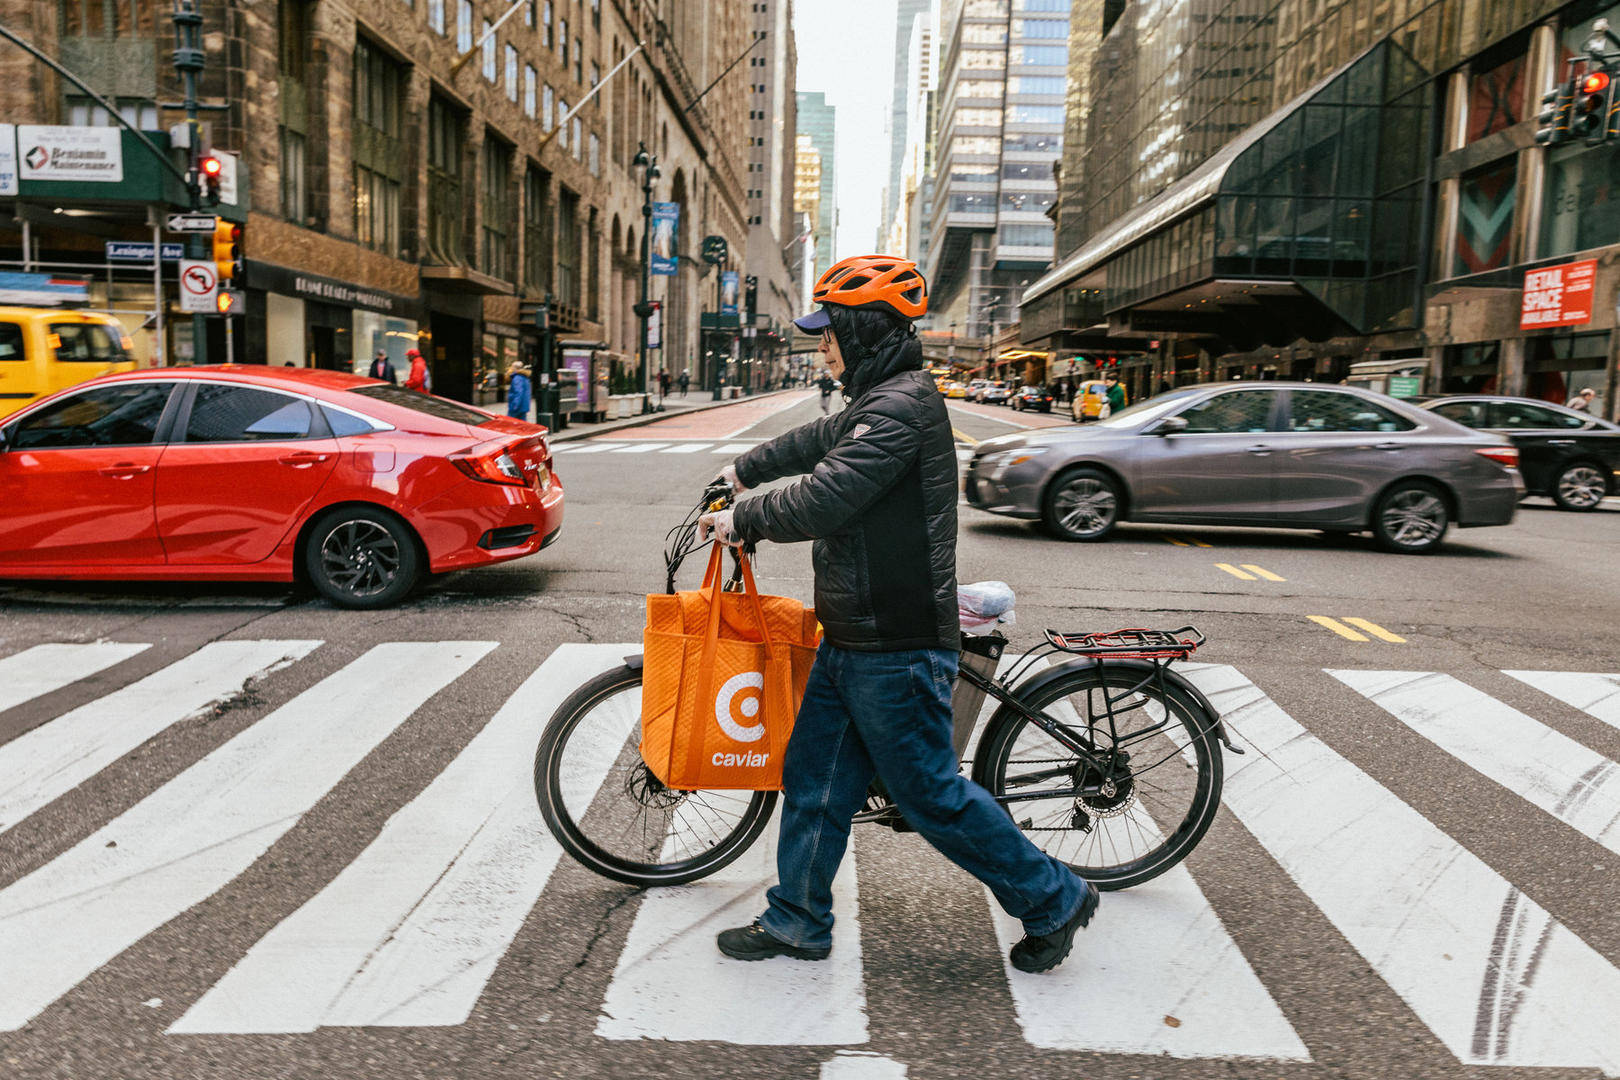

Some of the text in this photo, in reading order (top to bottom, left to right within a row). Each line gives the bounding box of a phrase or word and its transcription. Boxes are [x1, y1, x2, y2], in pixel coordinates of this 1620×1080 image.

[51, 147, 106, 160] Benjamin
[50, 160, 116, 170] Maintenance
[108, 244, 183, 258] Lexingto Ave
[1525, 268, 1564, 292] RETAIL
[1523, 287, 1563, 312] SPACE
[711, 750, 770, 767] caviar
